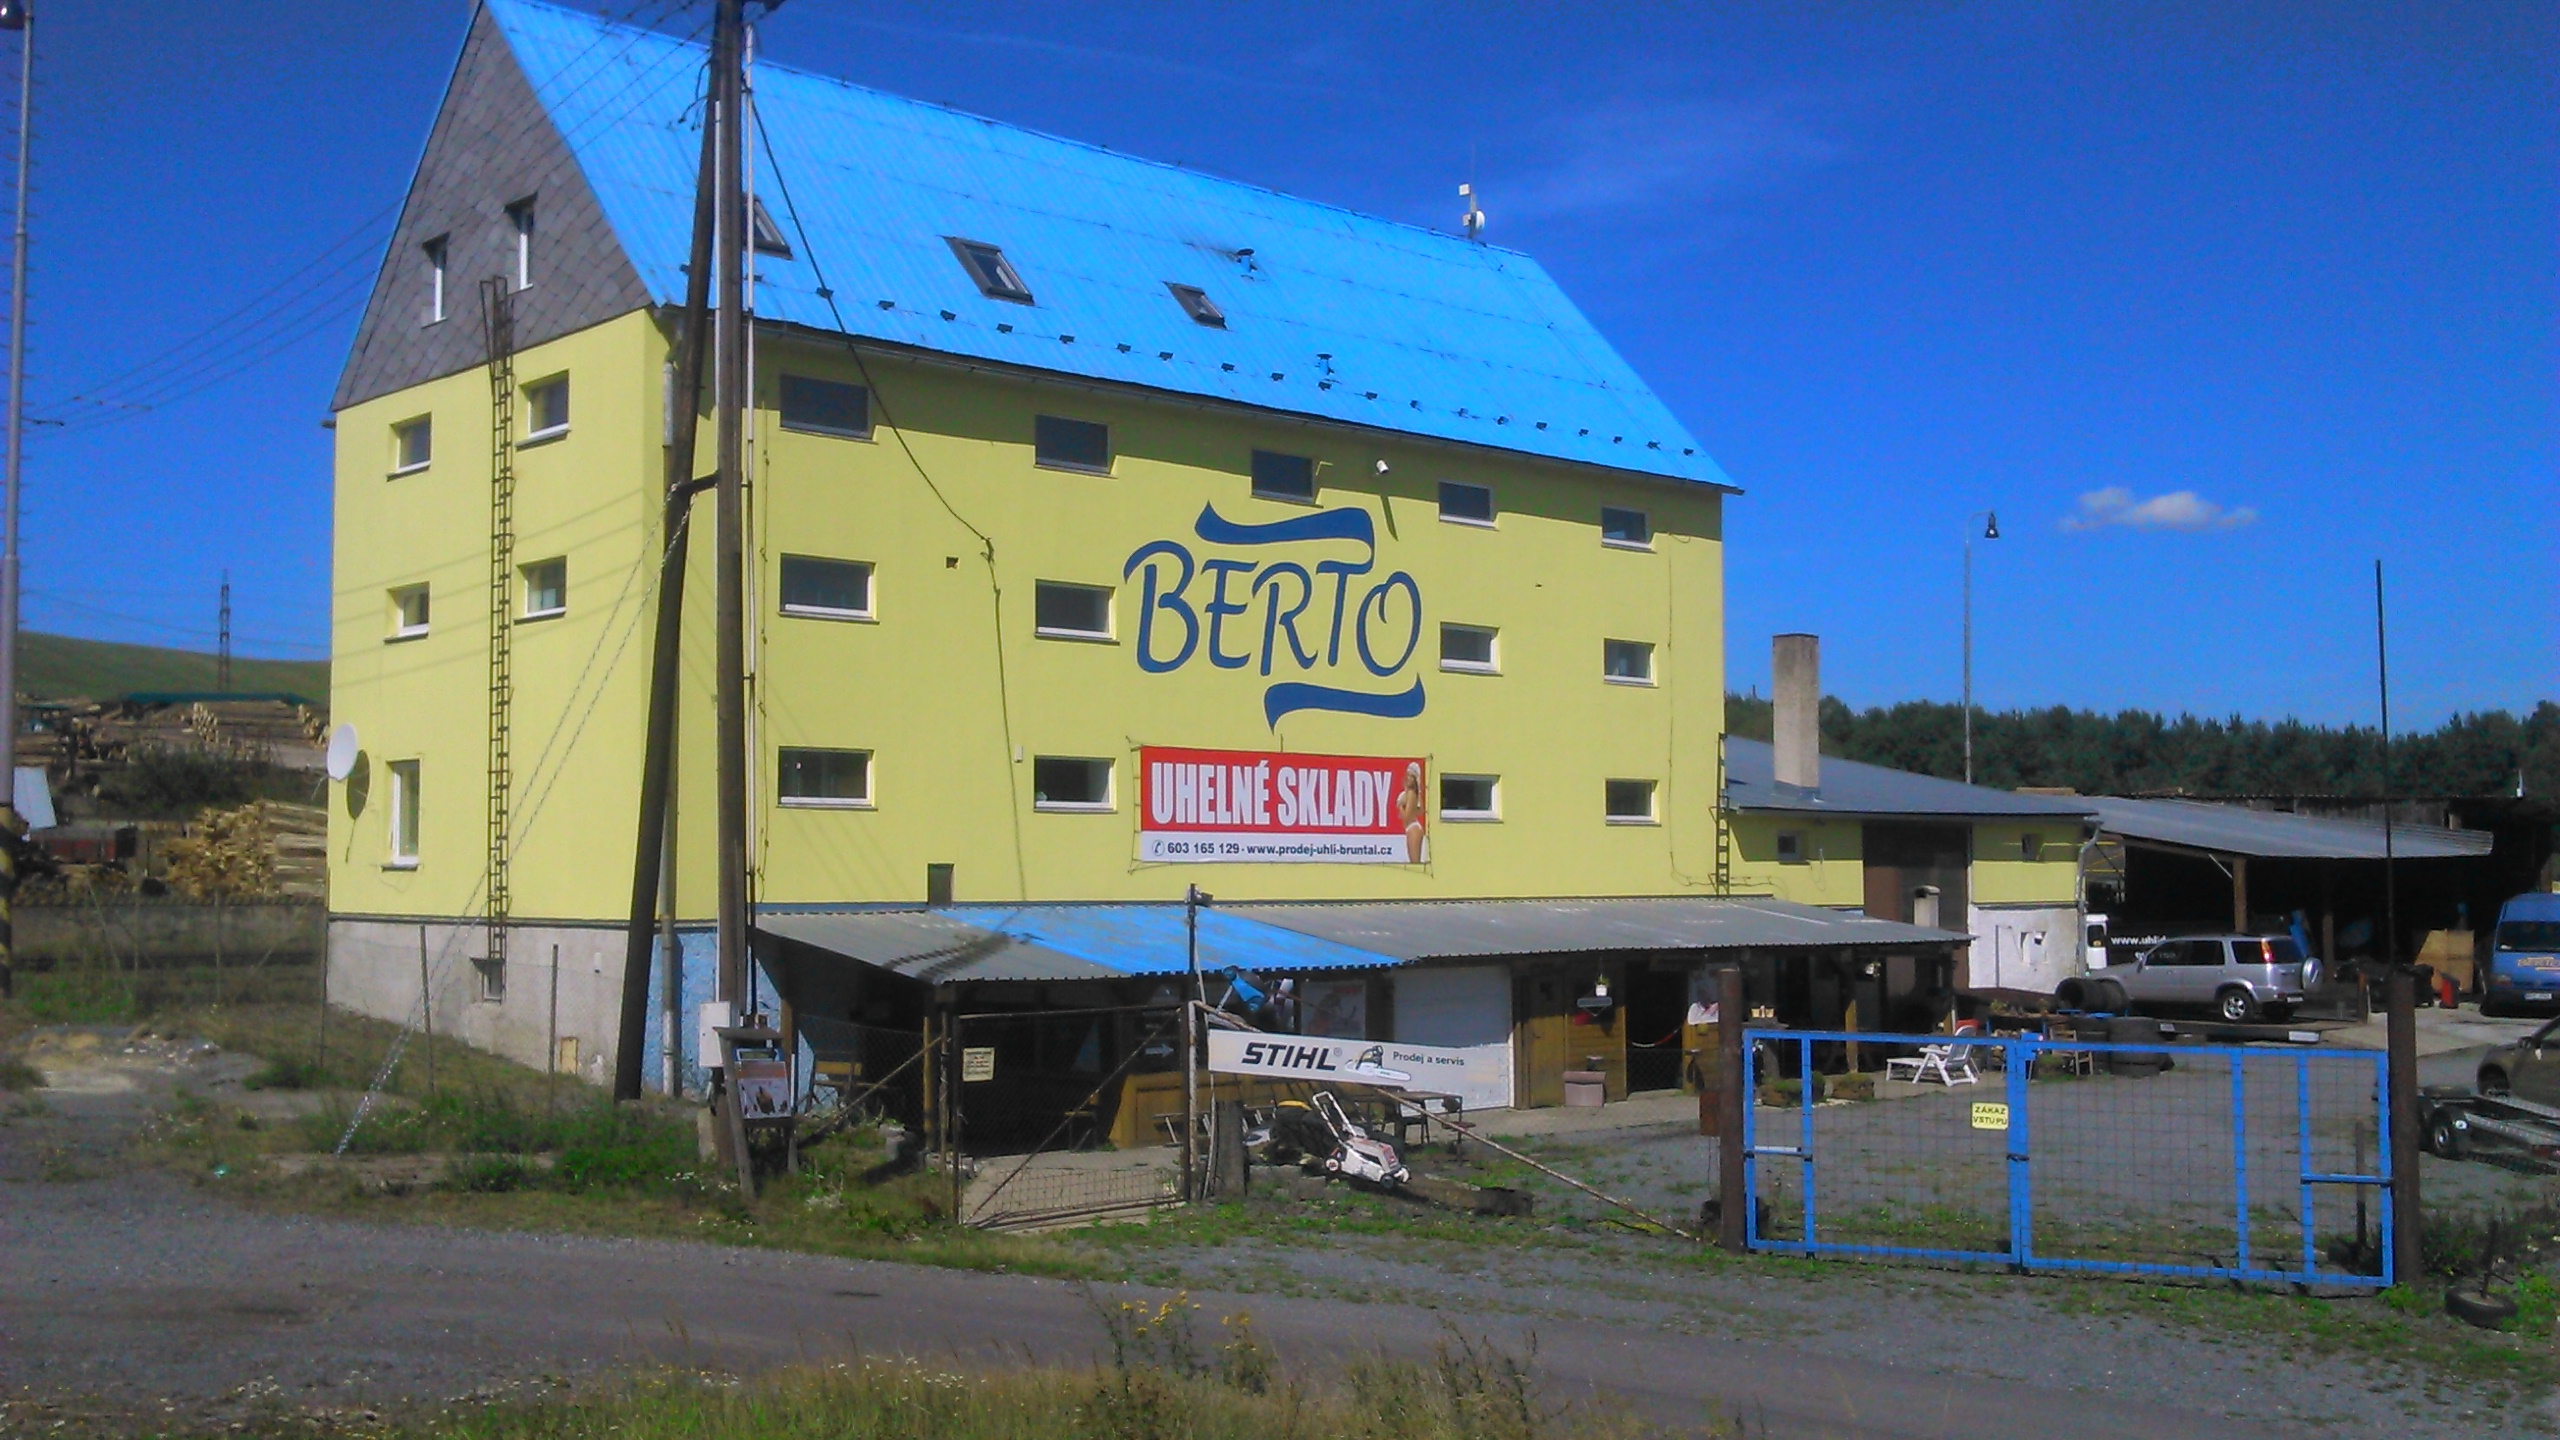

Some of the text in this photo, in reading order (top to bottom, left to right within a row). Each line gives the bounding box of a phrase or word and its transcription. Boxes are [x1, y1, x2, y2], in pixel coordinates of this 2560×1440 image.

[1123, 501, 1423, 677] BERTO
[1151, 760, 1392, 828] UHELNÉ SKLADY
[1167, 842, 1393, 857] 603 165 129 www.prodej-uhli-bruntal.cz
[1241, 1042, 1337, 1071] STIHL
[1393, 1051, 1424, 1065] Prodej
[1435, 1055, 1465, 1066] servis
[1973, 1116, 2007, 1125] VSTUPU
